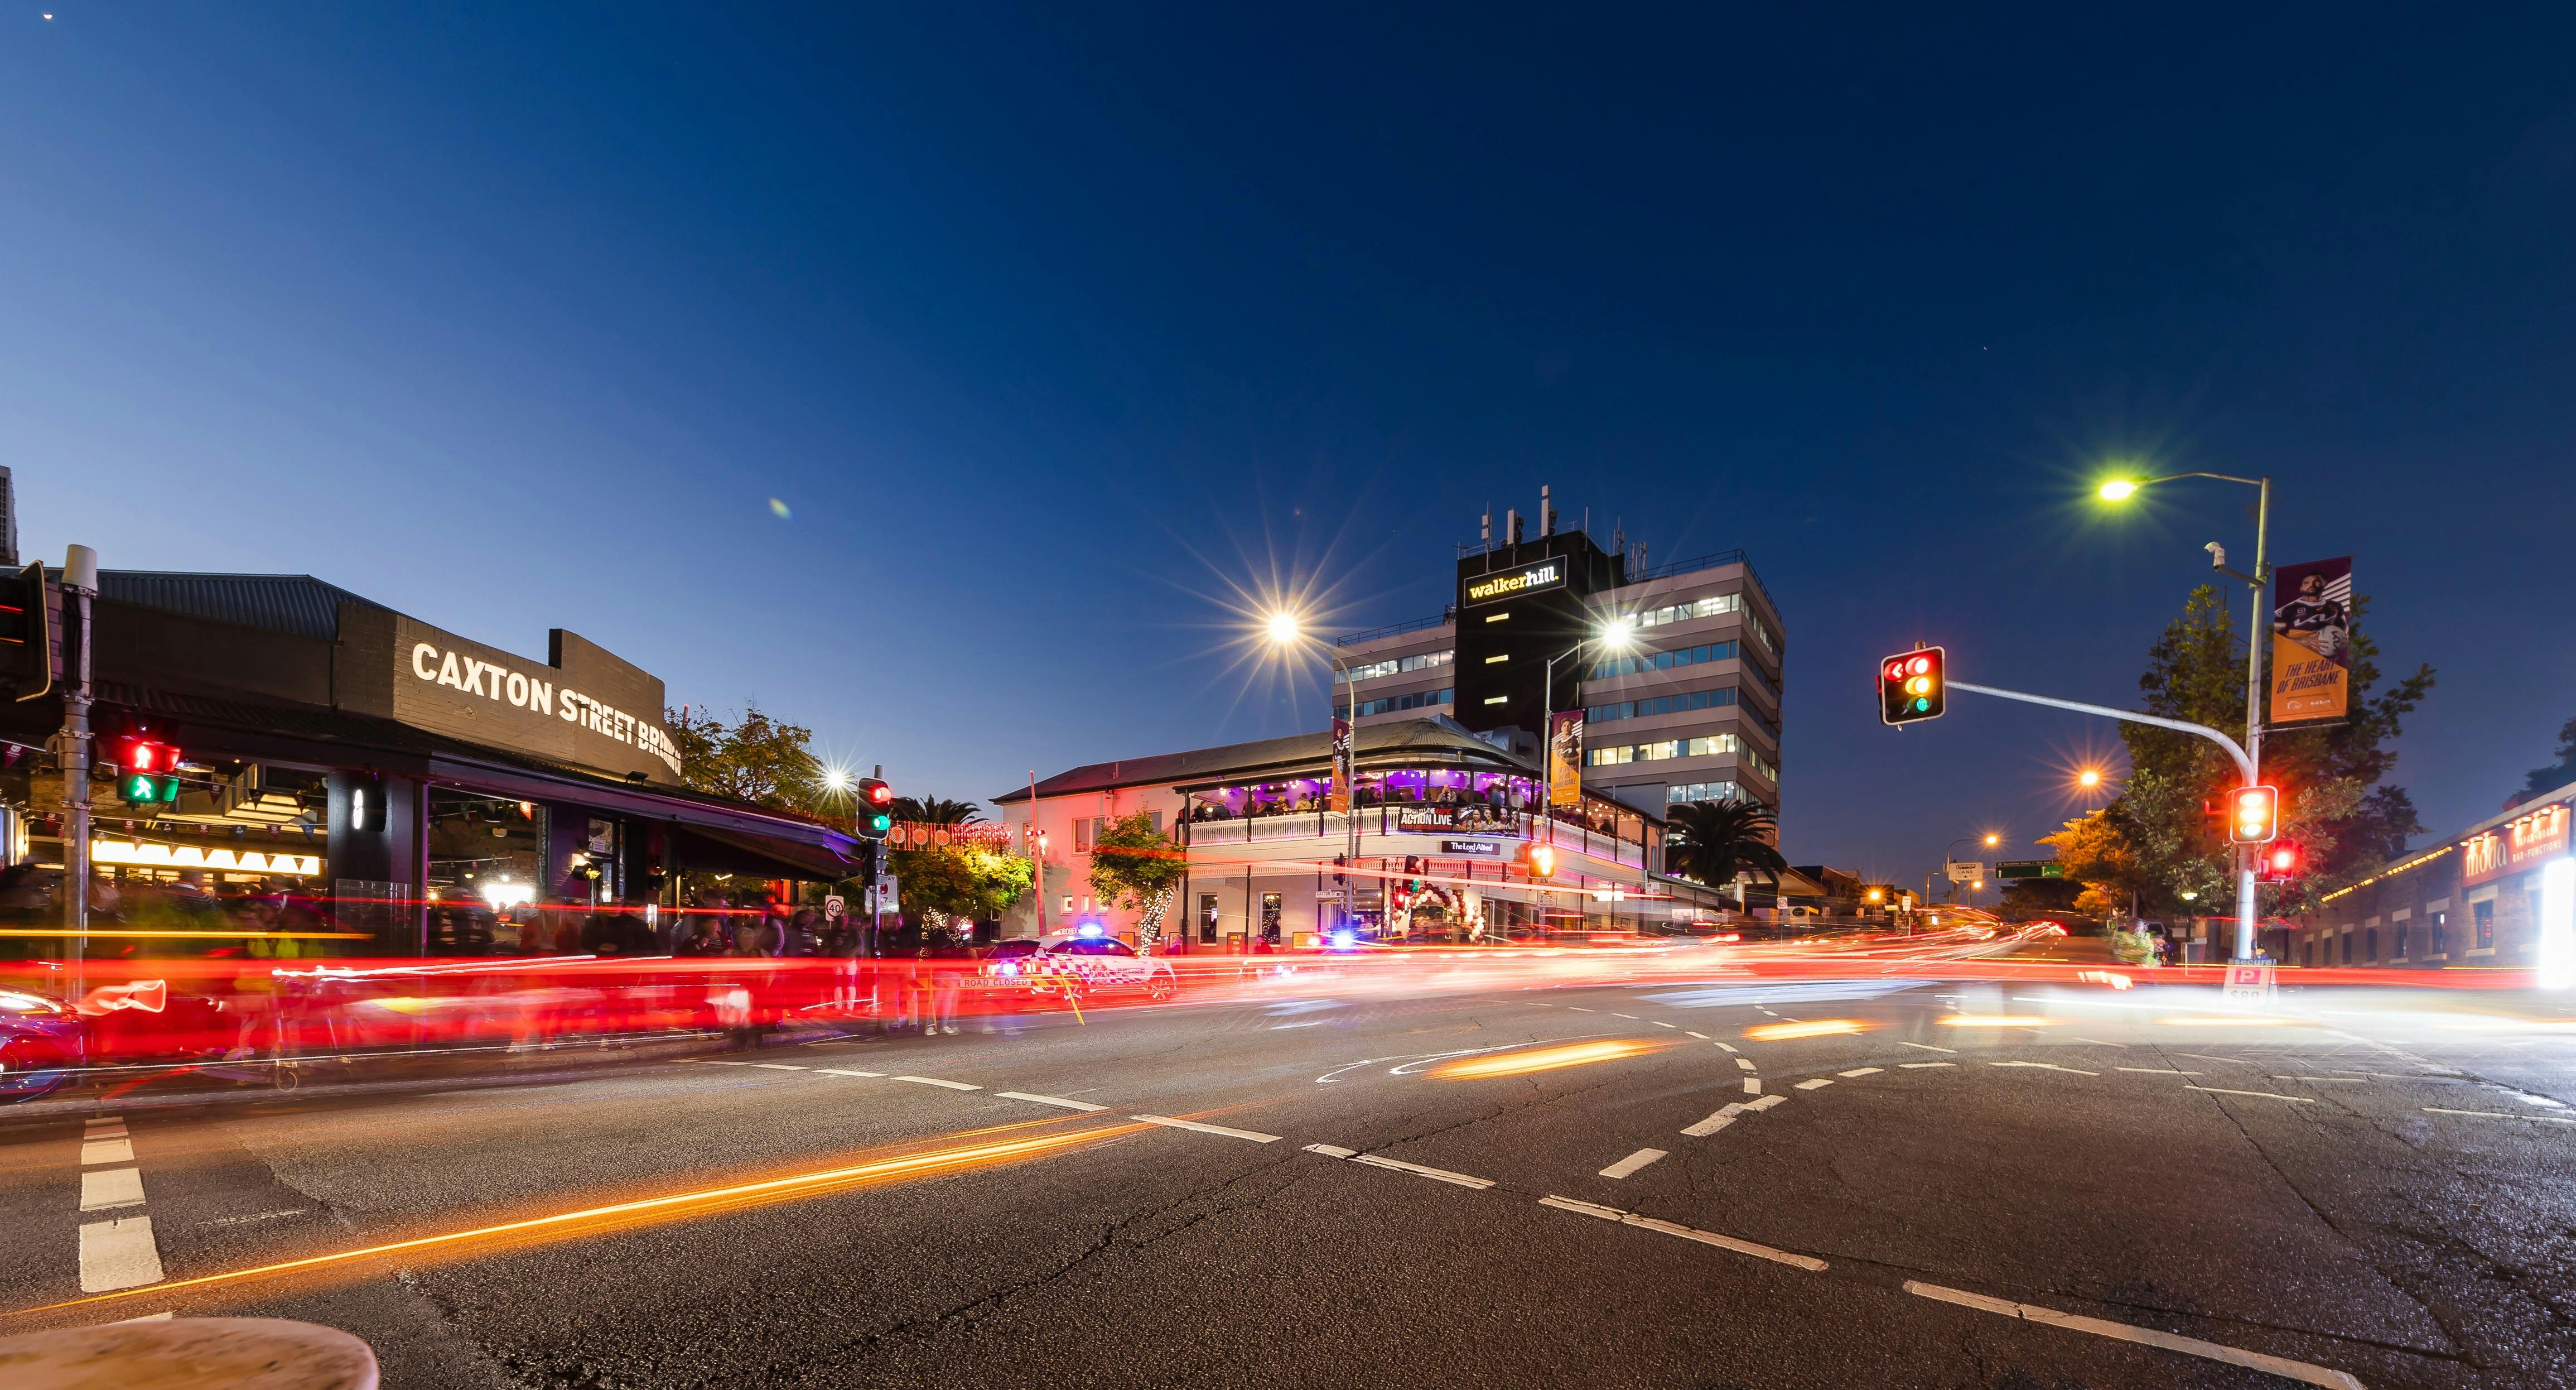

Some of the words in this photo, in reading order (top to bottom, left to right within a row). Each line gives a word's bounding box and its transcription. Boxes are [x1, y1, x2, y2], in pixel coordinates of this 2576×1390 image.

[1469, 566, 1559, 599] walkerhill.
[2285, 662, 2305, 678] THE
[2304, 656, 2339, 674] HEART
[2276, 679, 2291, 694] OF
[2290, 670, 2342, 691] BRISBANE
[412, 643, 552, 715] CAXTON
[558, 688, 635, 745] STREET
[1401, 814, 1432, 825] ACTION
[1433, 814, 1453, 826] LIVE
[2466, 842, 2507, 877] moda
[2528, 839, 2562, 858] FUNCTIONS
[829, 904, 841, 913] 40
[2240, 969, 2255, 983] P
